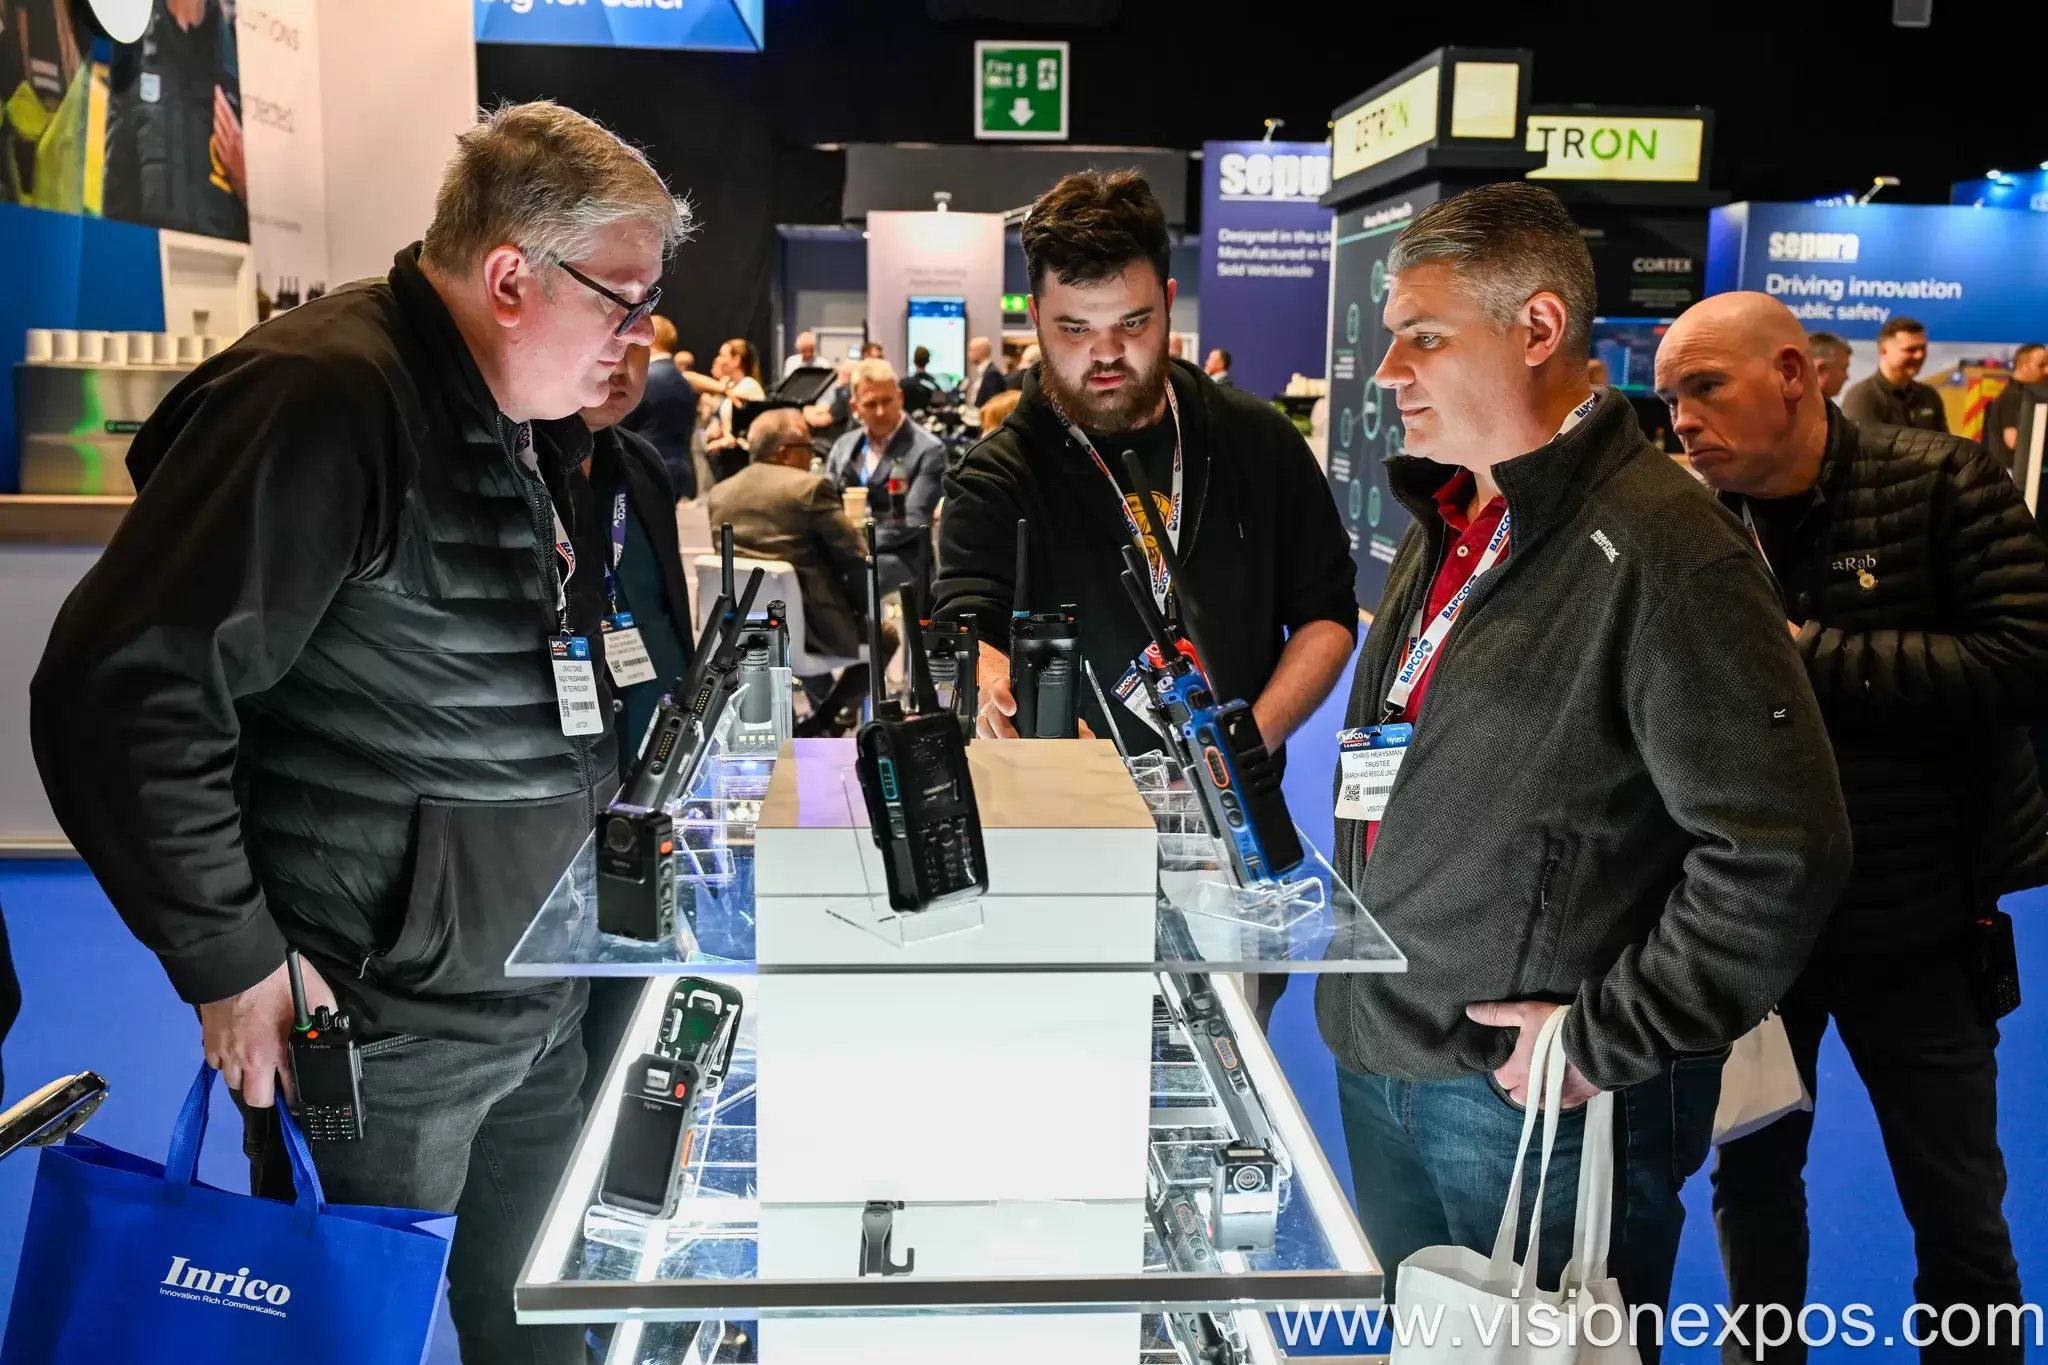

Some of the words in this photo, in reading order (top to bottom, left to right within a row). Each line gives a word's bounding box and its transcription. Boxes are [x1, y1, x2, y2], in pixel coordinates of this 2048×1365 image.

[1536, 127, 1658, 160] TRON
[1768, 231, 1860, 262] sepura
[1632, 257, 1692, 273] CORTEX
[1766, 273, 1844, 301] Driving
[1849, 275, 1962, 299] innovation
[1837, 302, 1891, 324] safety
[1845, 554, 1876, 571] Rab
[1399, 647, 1425, 684] BAPCO
[1386, 736, 1406, 745] Hytera
[1352, 752, 1369, 760] CHRIS
[1370, 750, 1402, 759] HEAYSMAN
[1365, 760, 1391, 768] TRUSTEE
[160, 1255, 291, 1305] Inrico
[159, 1287, 201, 1302] Innovation
[202, 1295, 220, 1305] Rich
[222, 1298, 287, 1318] Communications
